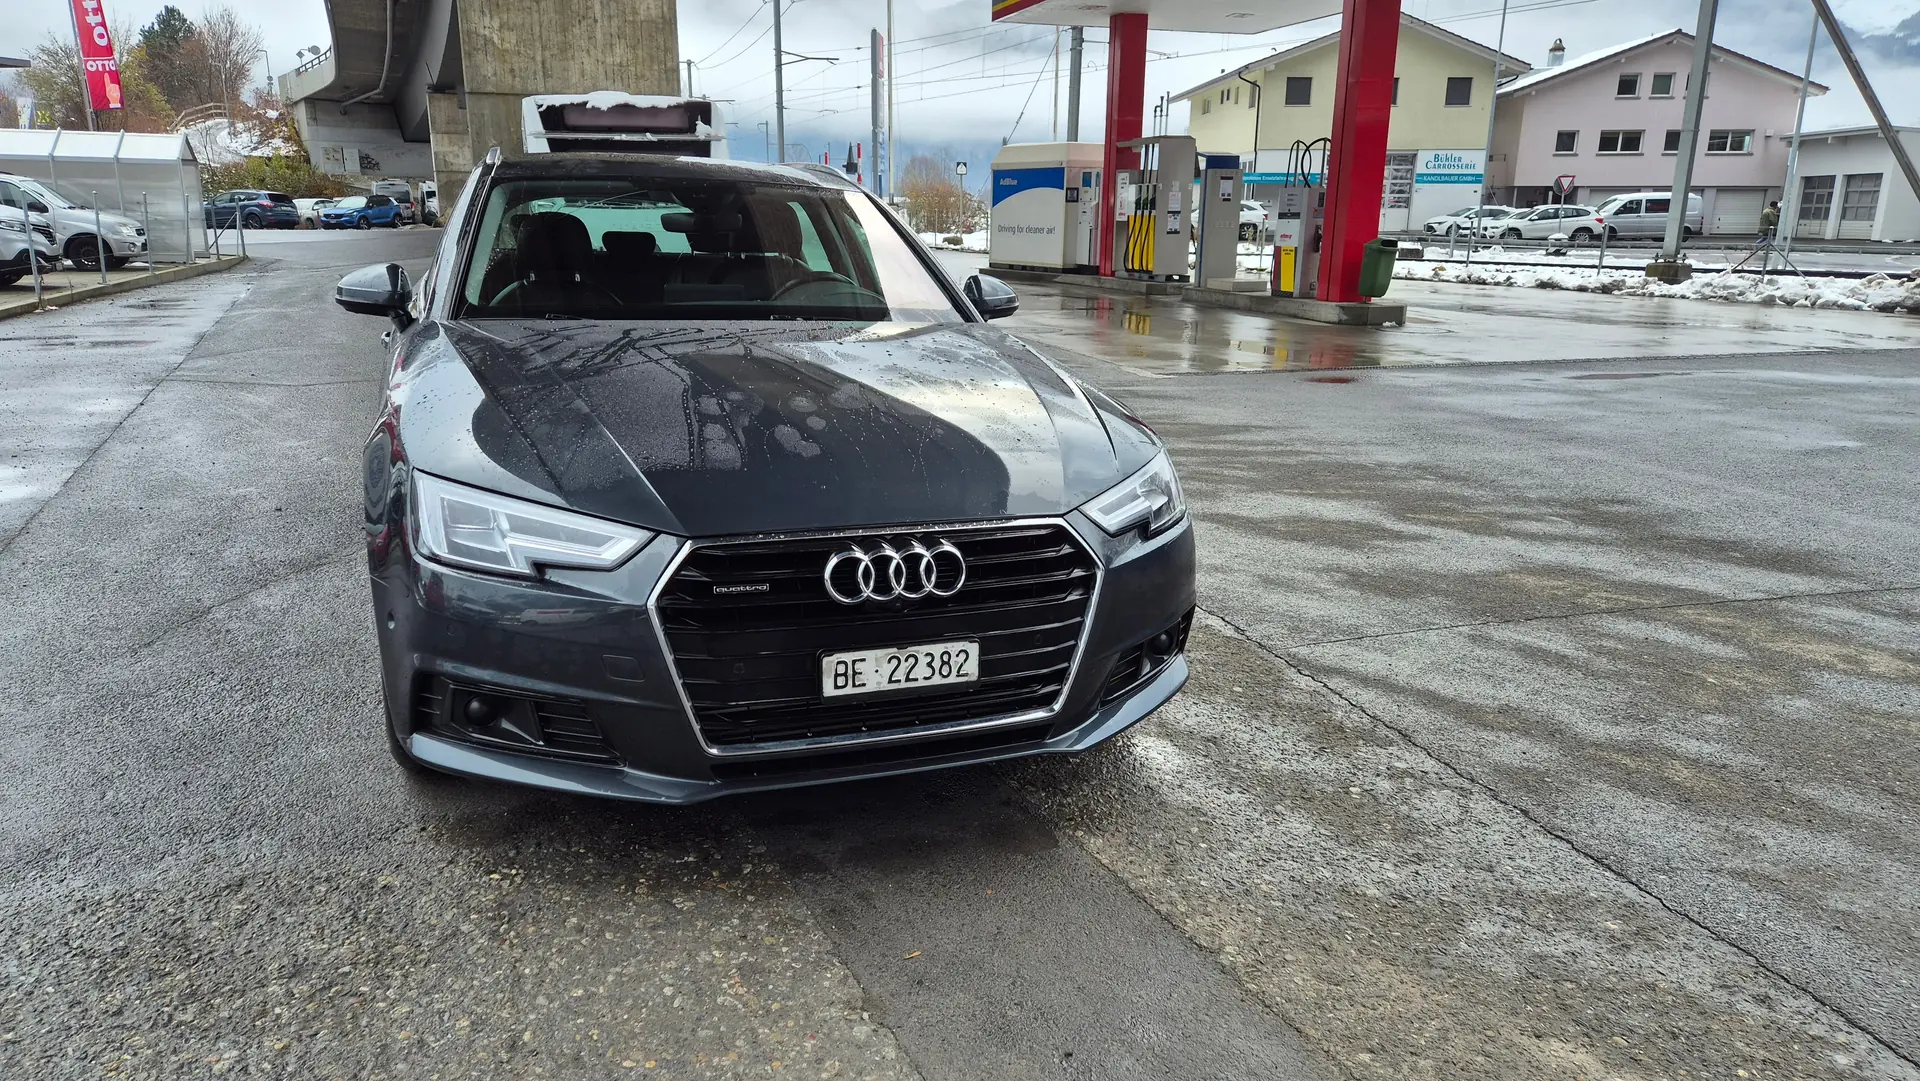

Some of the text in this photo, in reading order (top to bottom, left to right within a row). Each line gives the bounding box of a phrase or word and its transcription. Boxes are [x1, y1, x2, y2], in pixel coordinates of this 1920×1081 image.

[1000, 178, 1018, 186] AdBlue
[997, 224, 1056, 236] Driving for cleaner air!
[716, 585, 767, 595] quattro
[833, 649, 970, 690] BE 22382
